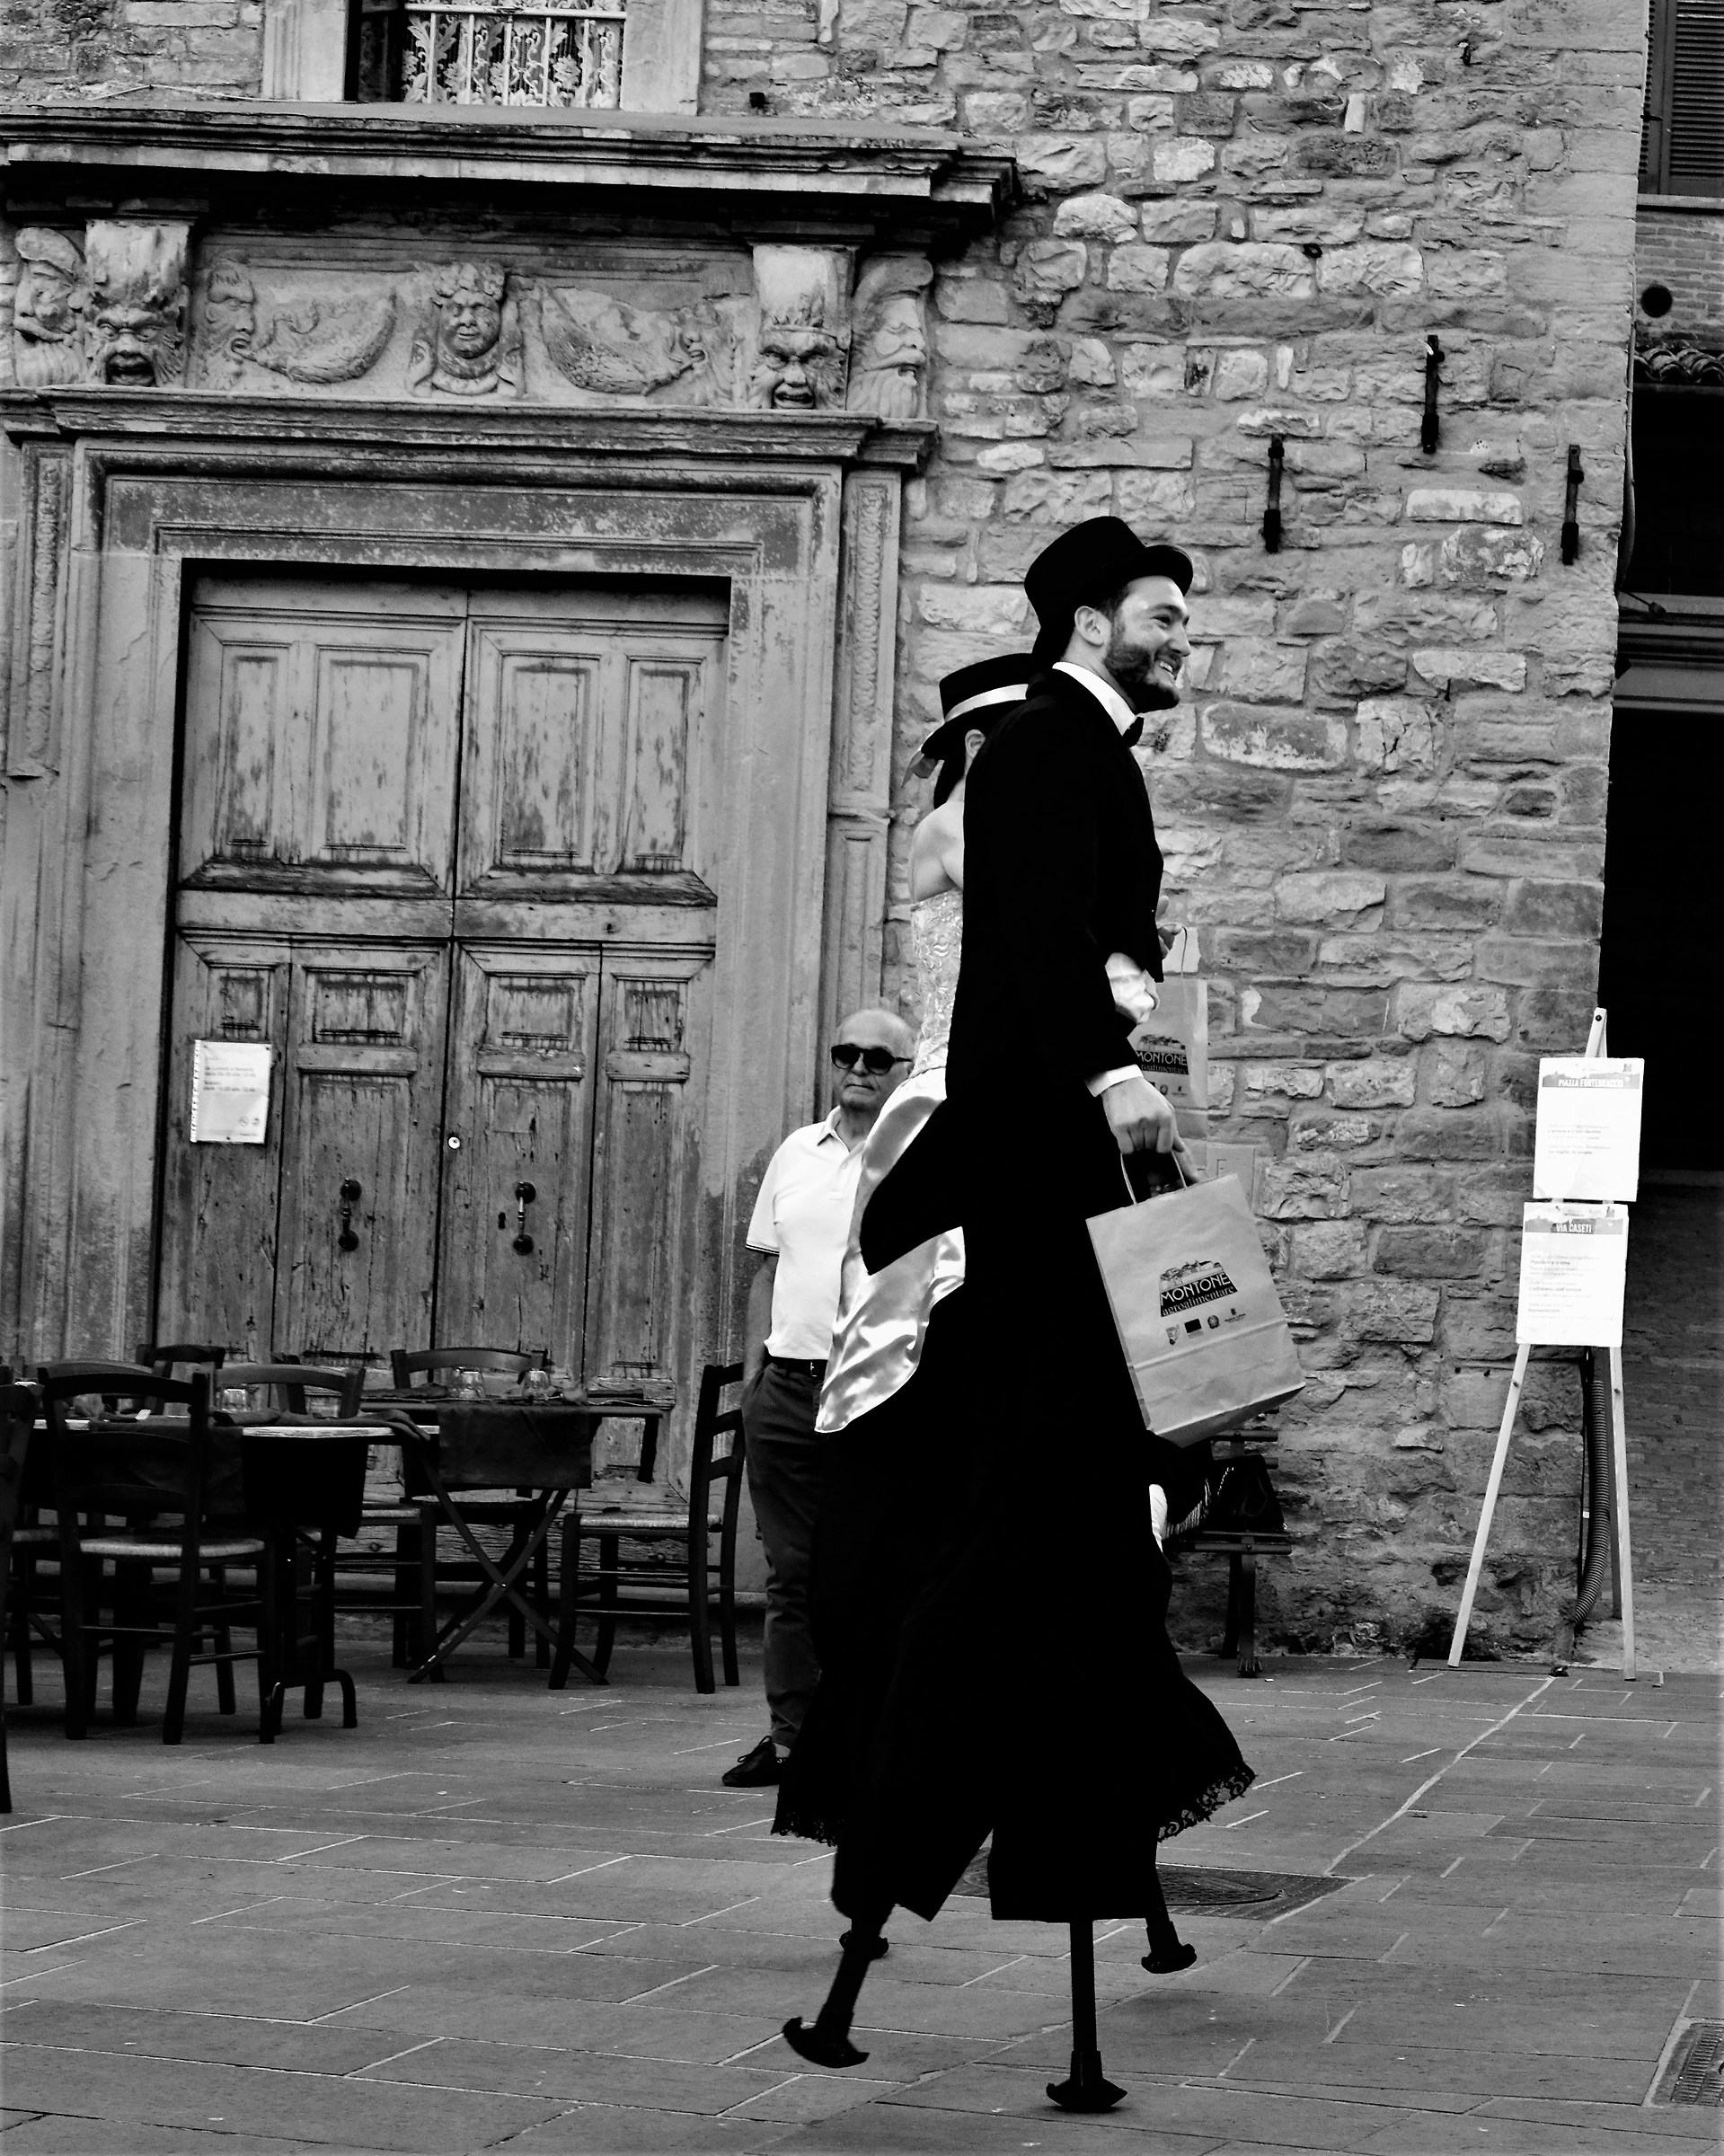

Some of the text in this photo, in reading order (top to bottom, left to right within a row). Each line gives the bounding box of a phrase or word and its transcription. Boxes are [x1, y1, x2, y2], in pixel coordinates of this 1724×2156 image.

[1558, 1079, 1578, 1087] PIAZZA
[1556, 1224, 1592, 1233] VIA CASETI
[1161, 1273, 1231, 1306] MONTONE
[1162, 1286, 1234, 1316] agroalimentare
